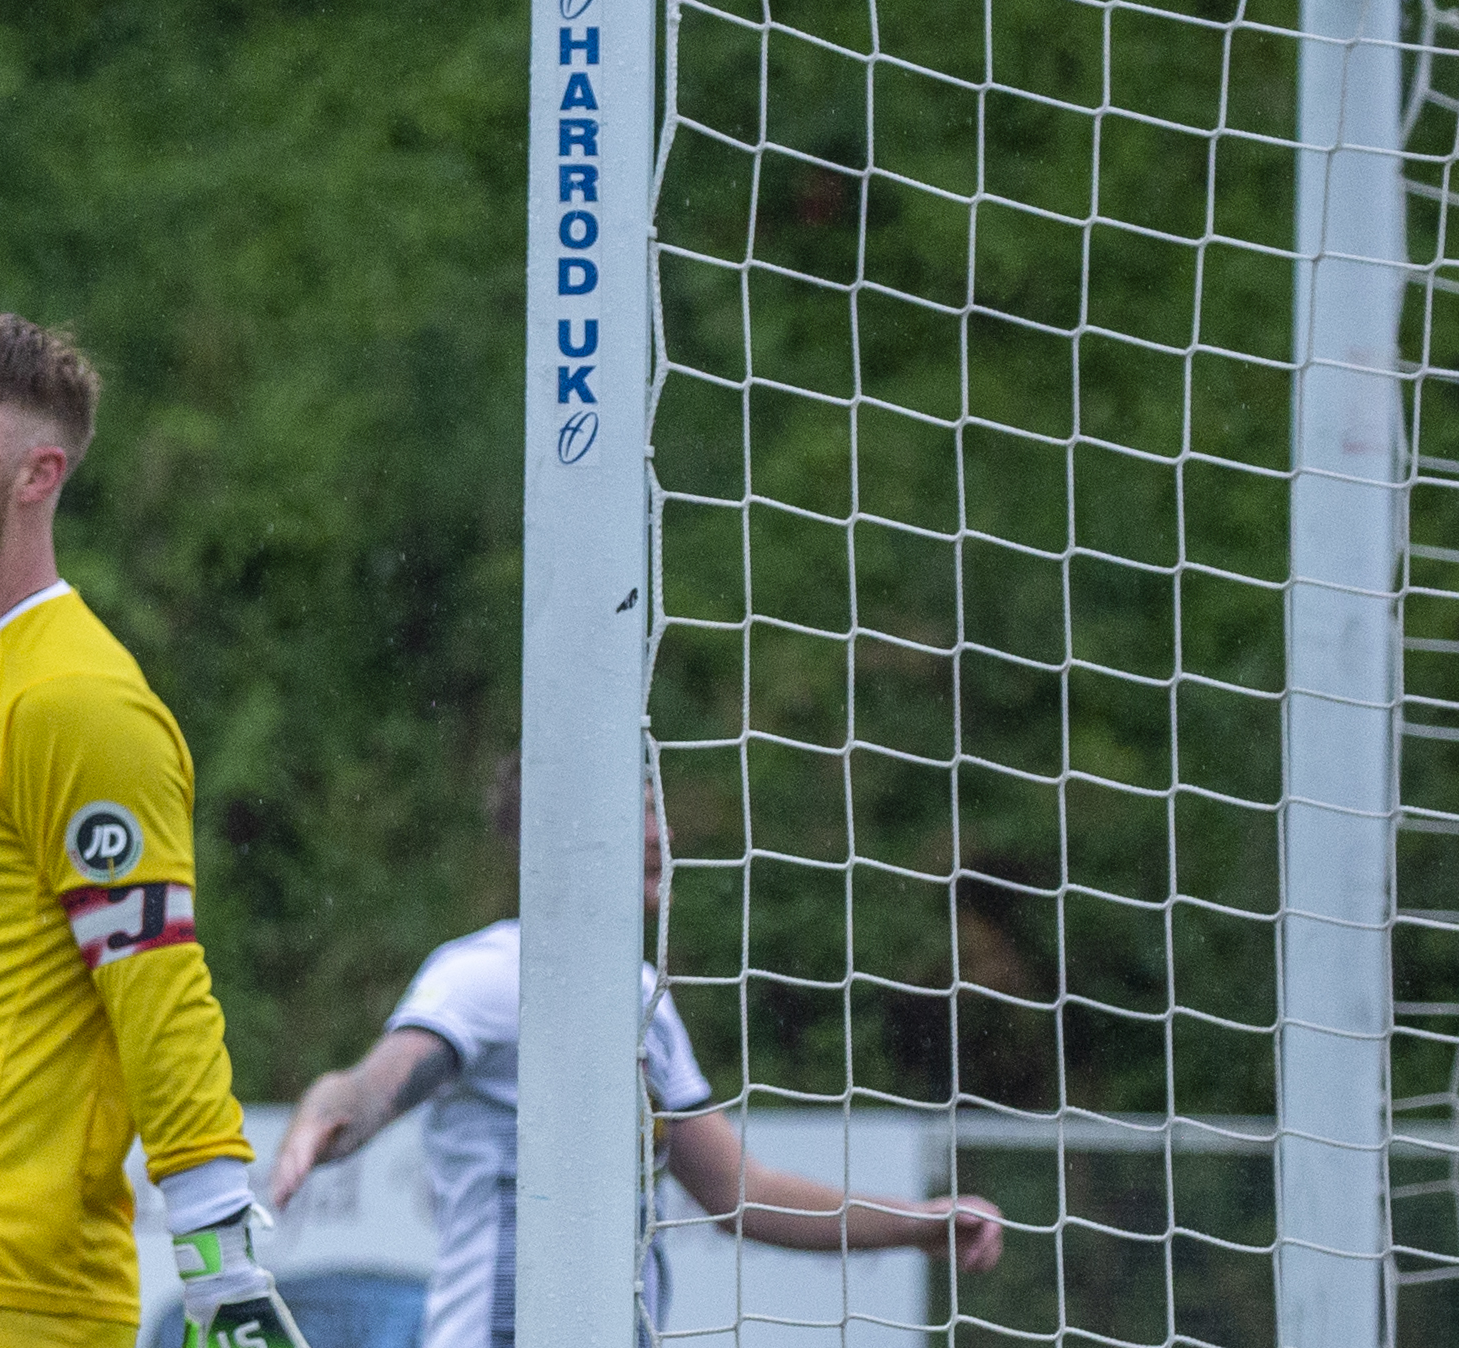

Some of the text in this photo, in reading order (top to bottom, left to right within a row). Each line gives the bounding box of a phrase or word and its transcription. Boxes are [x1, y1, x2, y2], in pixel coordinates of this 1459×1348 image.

[556, 26, 601, 404] HARROD UK
[83, 823, 128, 861] JD
